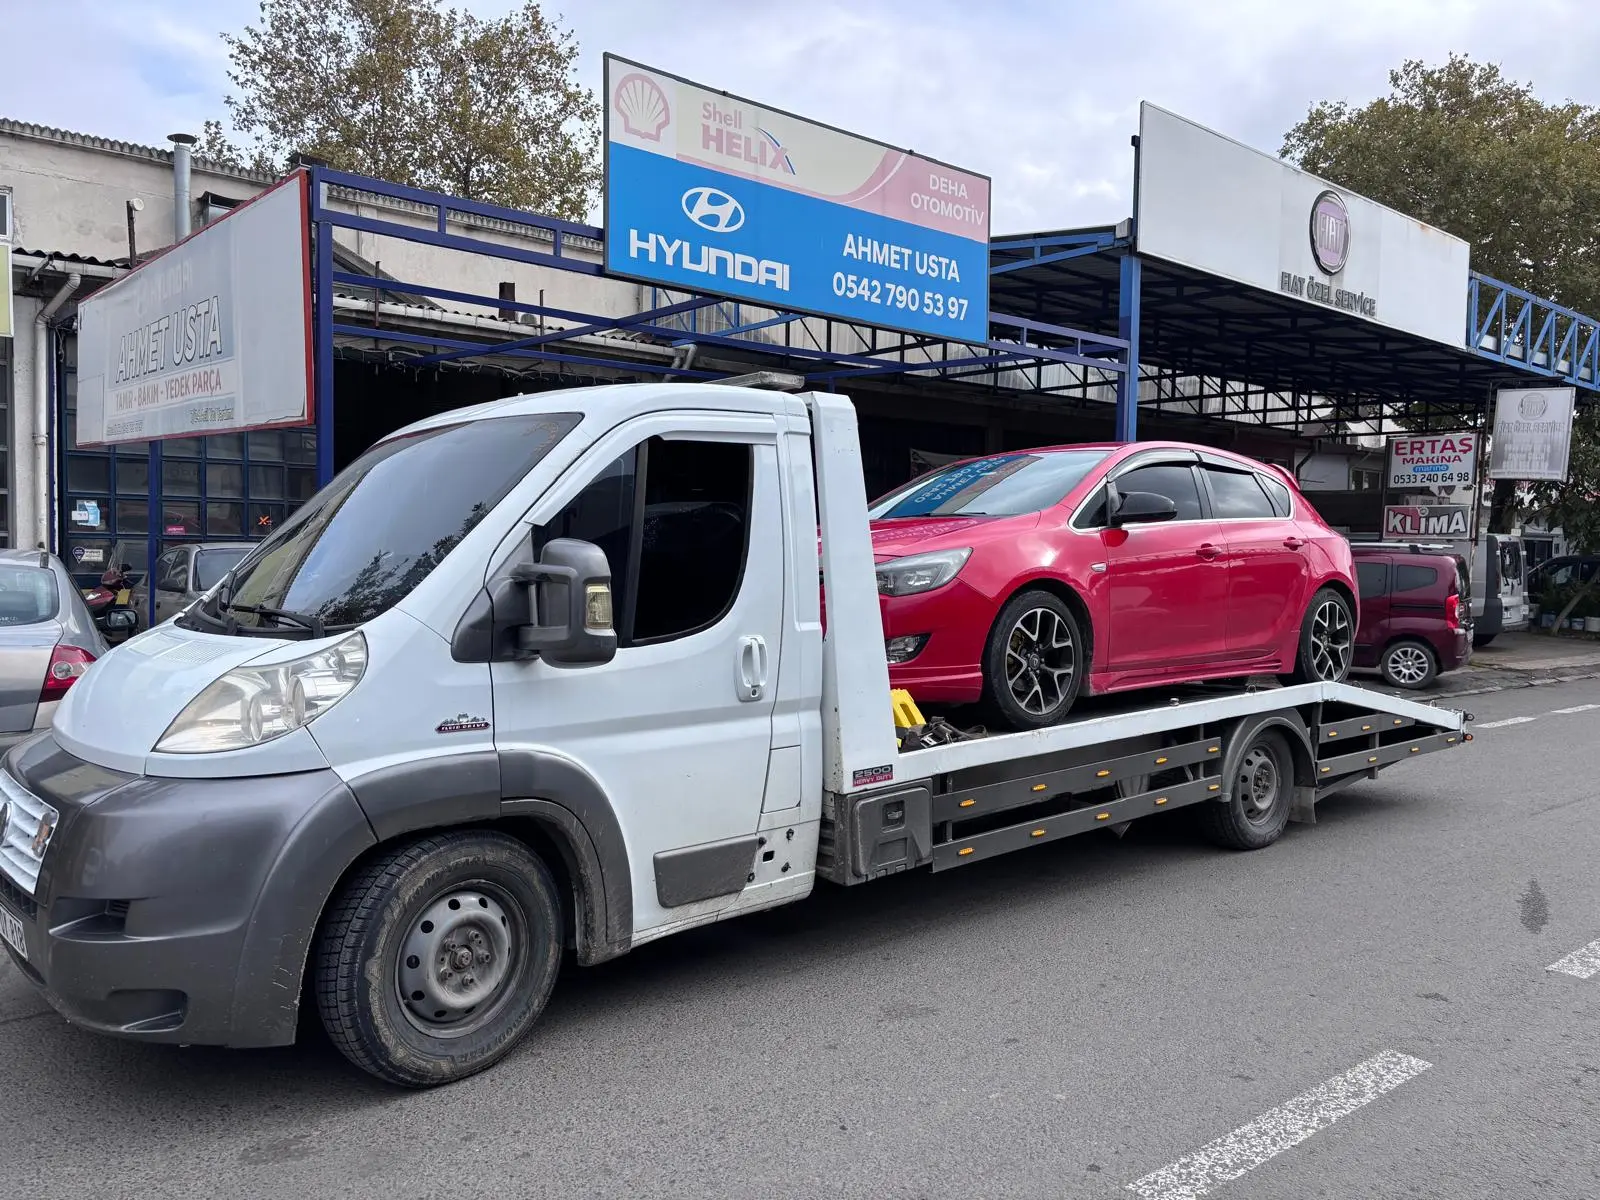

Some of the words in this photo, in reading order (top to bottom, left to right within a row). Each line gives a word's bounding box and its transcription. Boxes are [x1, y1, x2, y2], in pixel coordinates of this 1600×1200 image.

[702, 102, 742, 129] Shell
[701, 123, 791, 173] HELIX
[929, 174, 968, 199] DEHA
[910, 193, 984, 225] OTOMOTİV
[629, 228, 790, 292] HYUNDAI
[843, 233, 912, 271] AHMET
[915, 251, 960, 283] USTA
[832, 271, 881, 304] 0542
[885, 283, 919, 312] 790
[923, 291, 944, 316] 53
[948, 298, 969, 321] 97
[1280, 271, 1305, 296] FIAT
[1307, 276, 1333, 304] ÖZEL
[115, 316, 170, 384] AHMET
[173, 296, 222, 366] USTA
[137, 384, 159, 407] BAKIM
[164, 377, 191, 401] YEDEK
[191, 368, 222, 397] PARÇA
[1394, 437, 1473, 456] ERTAŞ
[1402, 454, 1462, 465] MAKİNA
[1393, 474, 1417, 484] 0533
[1420, 473, 1439, 483] 240
[1441, 472, 1453, 482] 64
[1457, 472, 1470, 482] 98
[854, 766, 891, 777] 2500
[854, 776, 874, 785] HEAVY
